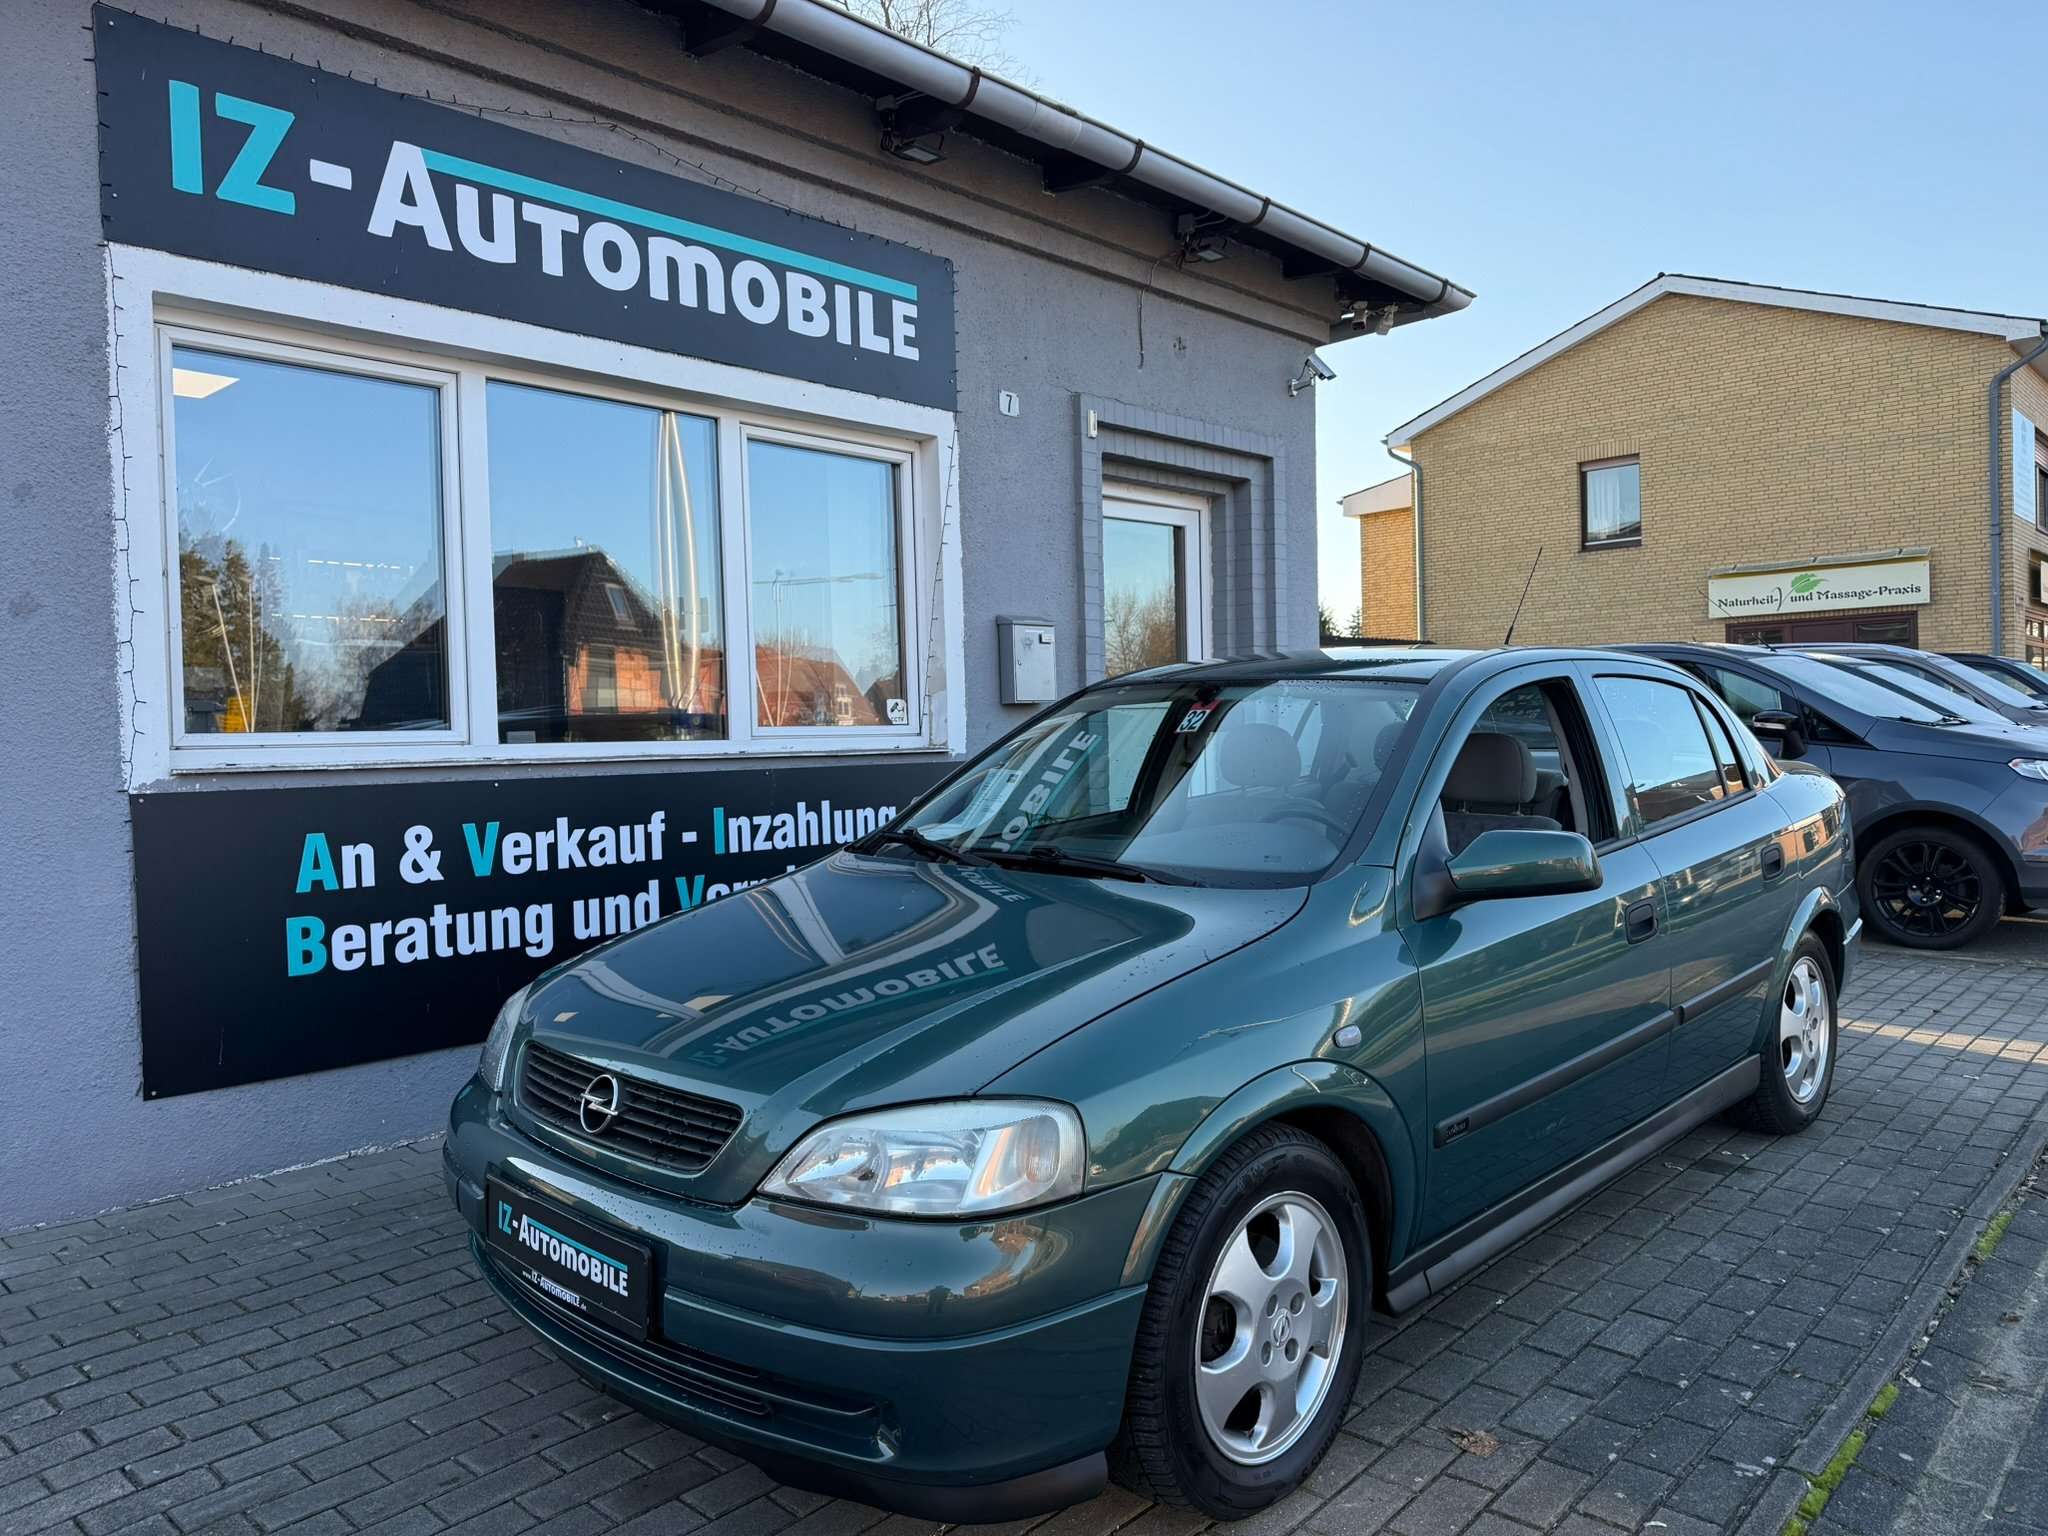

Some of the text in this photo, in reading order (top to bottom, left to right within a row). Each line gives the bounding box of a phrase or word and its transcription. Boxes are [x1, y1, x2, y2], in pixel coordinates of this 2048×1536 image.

[1006, 394, 1012, 413] 7
[1790, 591, 1814, 603] und
[1817, 584, 1922, 602] Massage-Praxis
[1180, 710, 1206, 731] 32
[296, 832, 376, 894] An
[399, 824, 445, 884] &
[462, 811, 666, 877] Verkauf
[682, 831, 697, 843] -
[286, 903, 554, 978] Beratung
[573, 879, 661, 940] und
